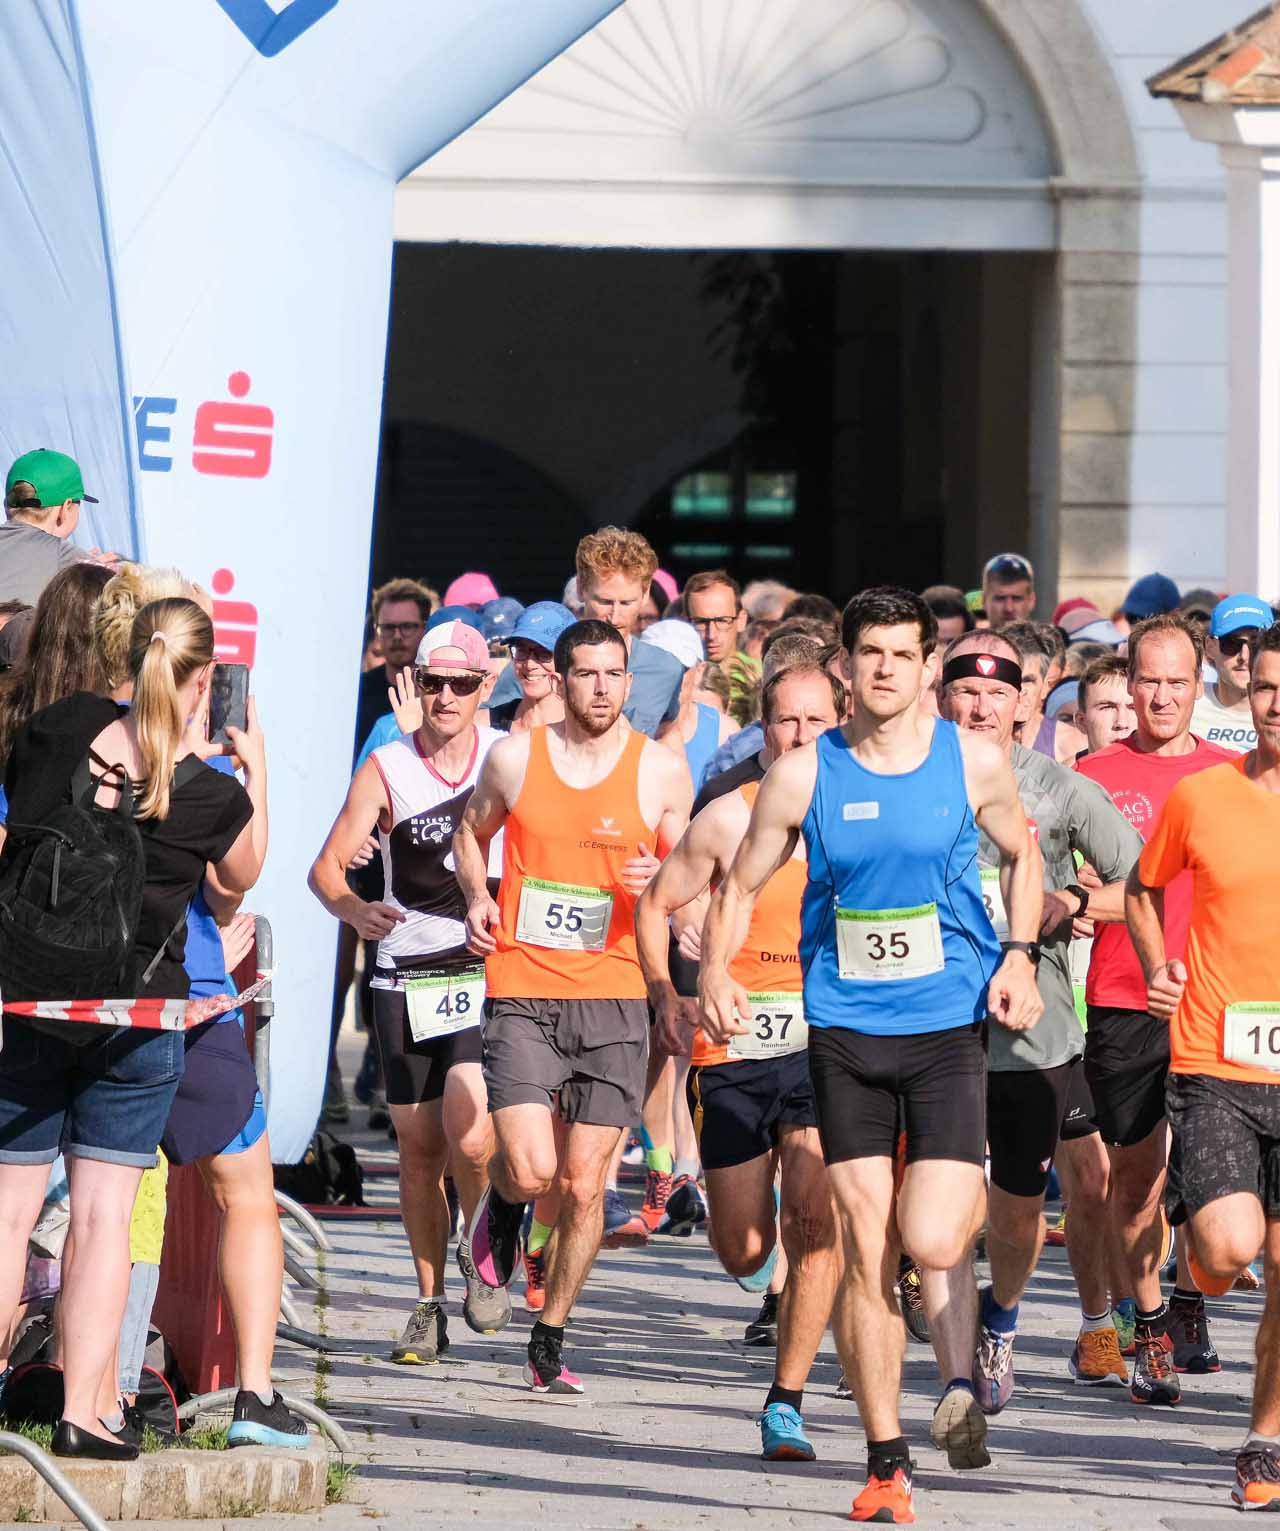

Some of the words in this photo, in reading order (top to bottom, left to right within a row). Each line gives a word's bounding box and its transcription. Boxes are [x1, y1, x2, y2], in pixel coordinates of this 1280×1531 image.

[1122, 803, 1144, 814] AC
[545, 903, 584, 932] 55
[866, 932, 909, 960] 35
[436, 992, 470, 1017] 48
[755, 1014, 793, 1040] 37
